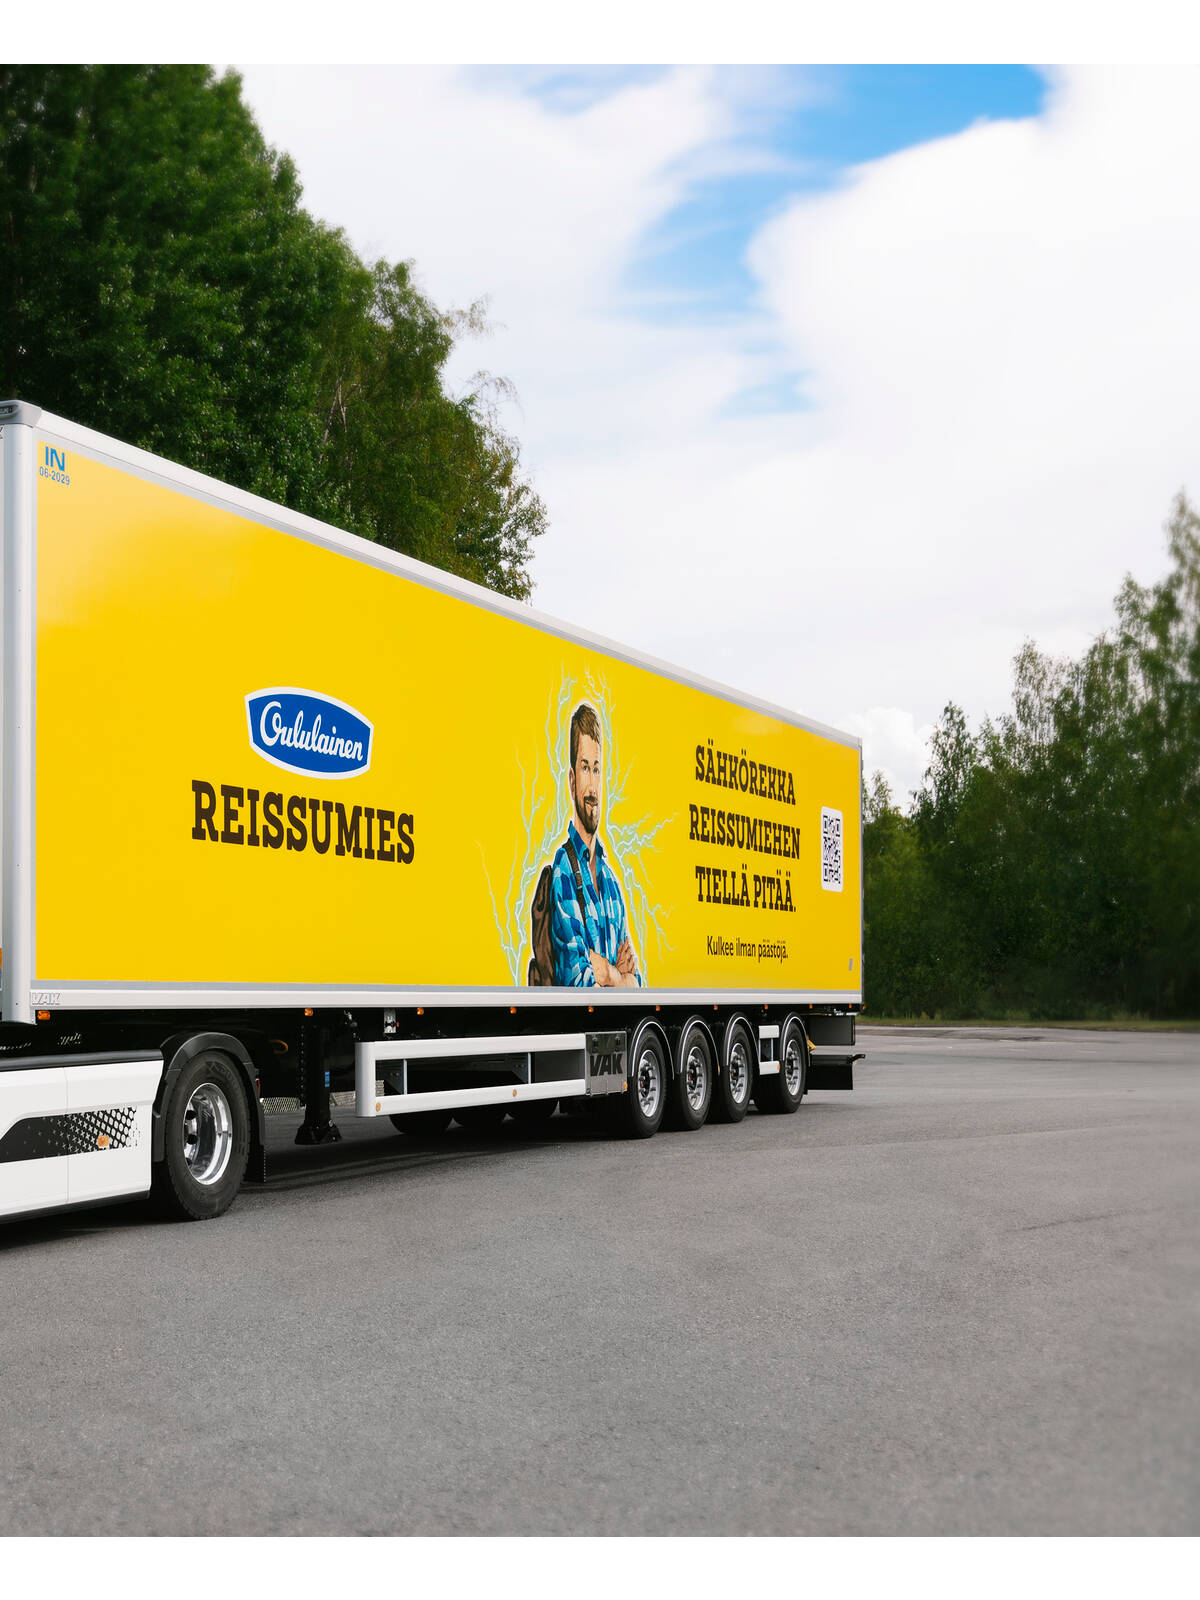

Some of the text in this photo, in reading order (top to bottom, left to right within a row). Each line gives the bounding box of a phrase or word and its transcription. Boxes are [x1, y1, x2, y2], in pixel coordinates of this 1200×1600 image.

[39, 466, 71, 486] 06-2029
[45, 446, 66, 472] IN
[259, 700, 364, 762] Oululainen
[695, 738, 796, 805] SÄHKÖREKKA
[191, 779, 415, 865] REISSUMIES
[689, 803, 801, 860] REISSUMIEHEN
[696, 863, 797, 913] TIELLÄ PITÄÄ.
[707, 935, 789, 964] Kulkee ilman päästöjä.
[589, 1052, 623, 1077] VAK
